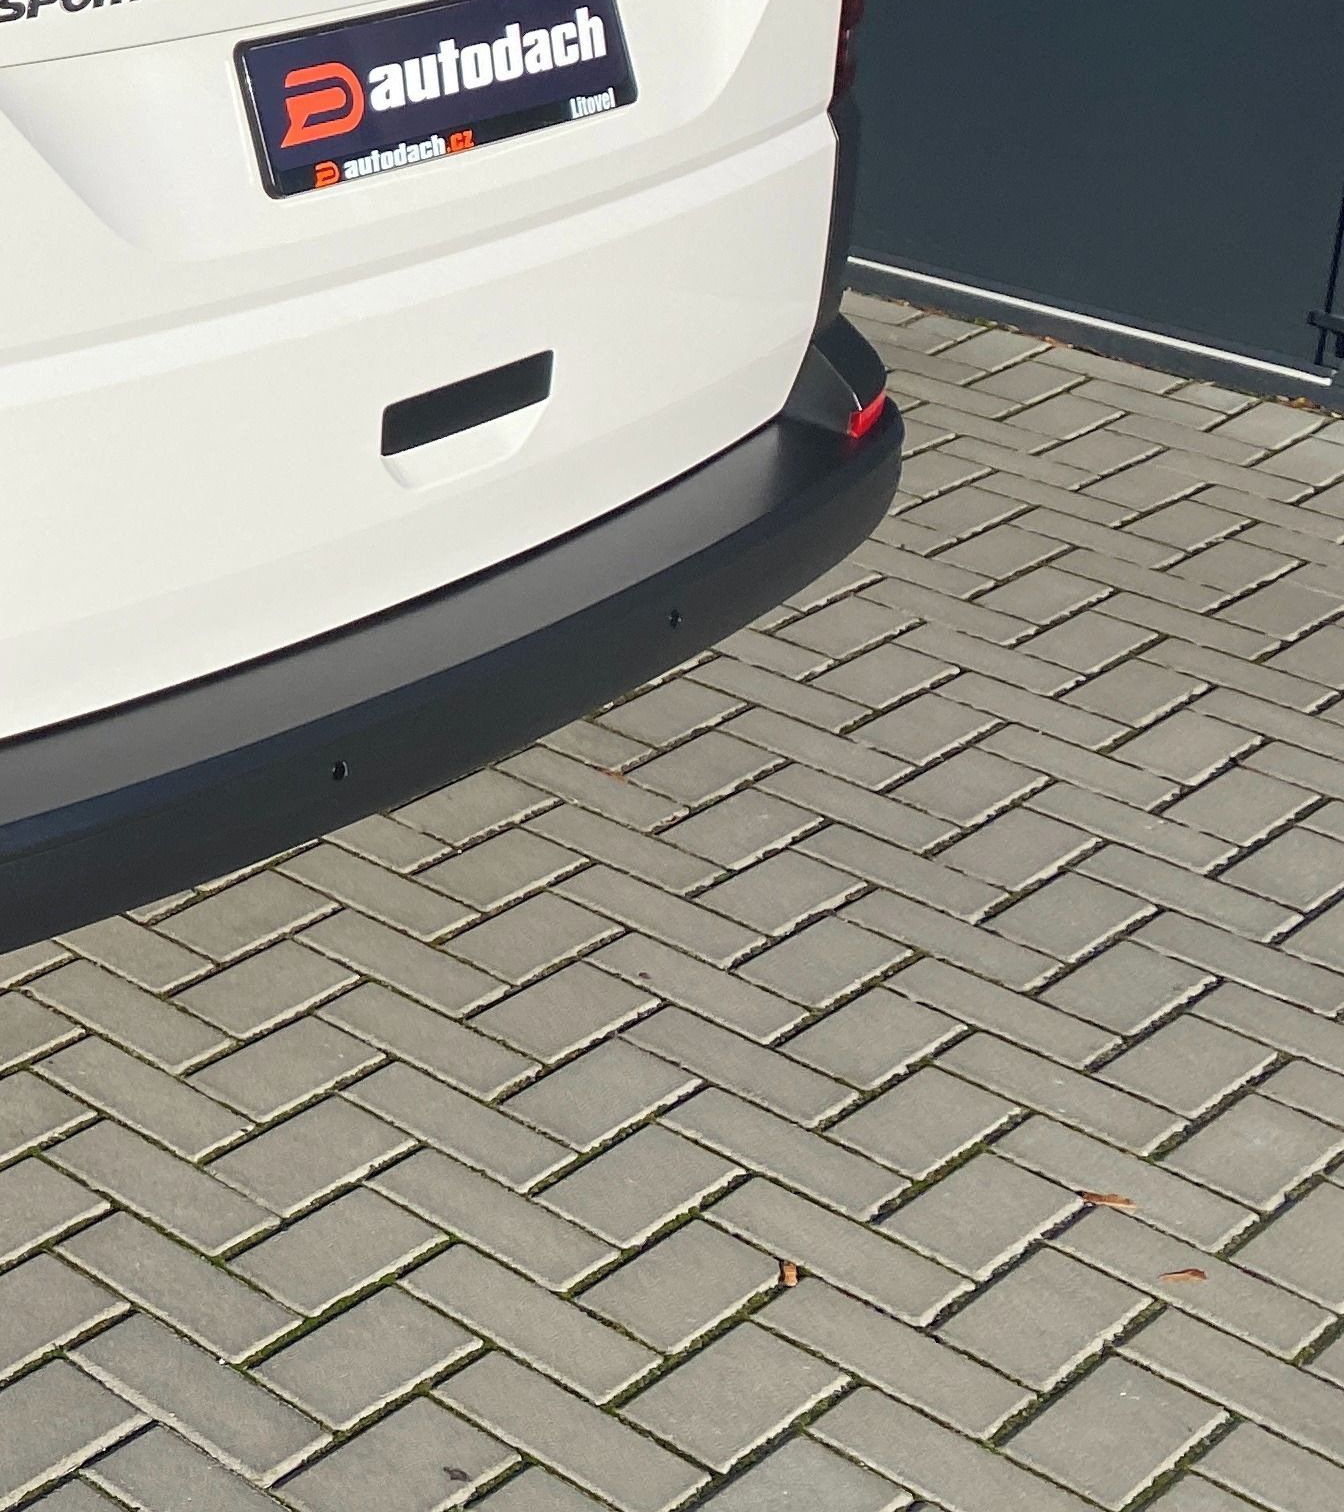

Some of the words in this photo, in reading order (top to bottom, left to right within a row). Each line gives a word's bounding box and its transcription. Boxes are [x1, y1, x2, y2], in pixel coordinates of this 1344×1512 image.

[368, 6, 608, 112] autodach
[570, 87, 616, 120] Litovel
[343, 128, 476, 180] autodach.cz
